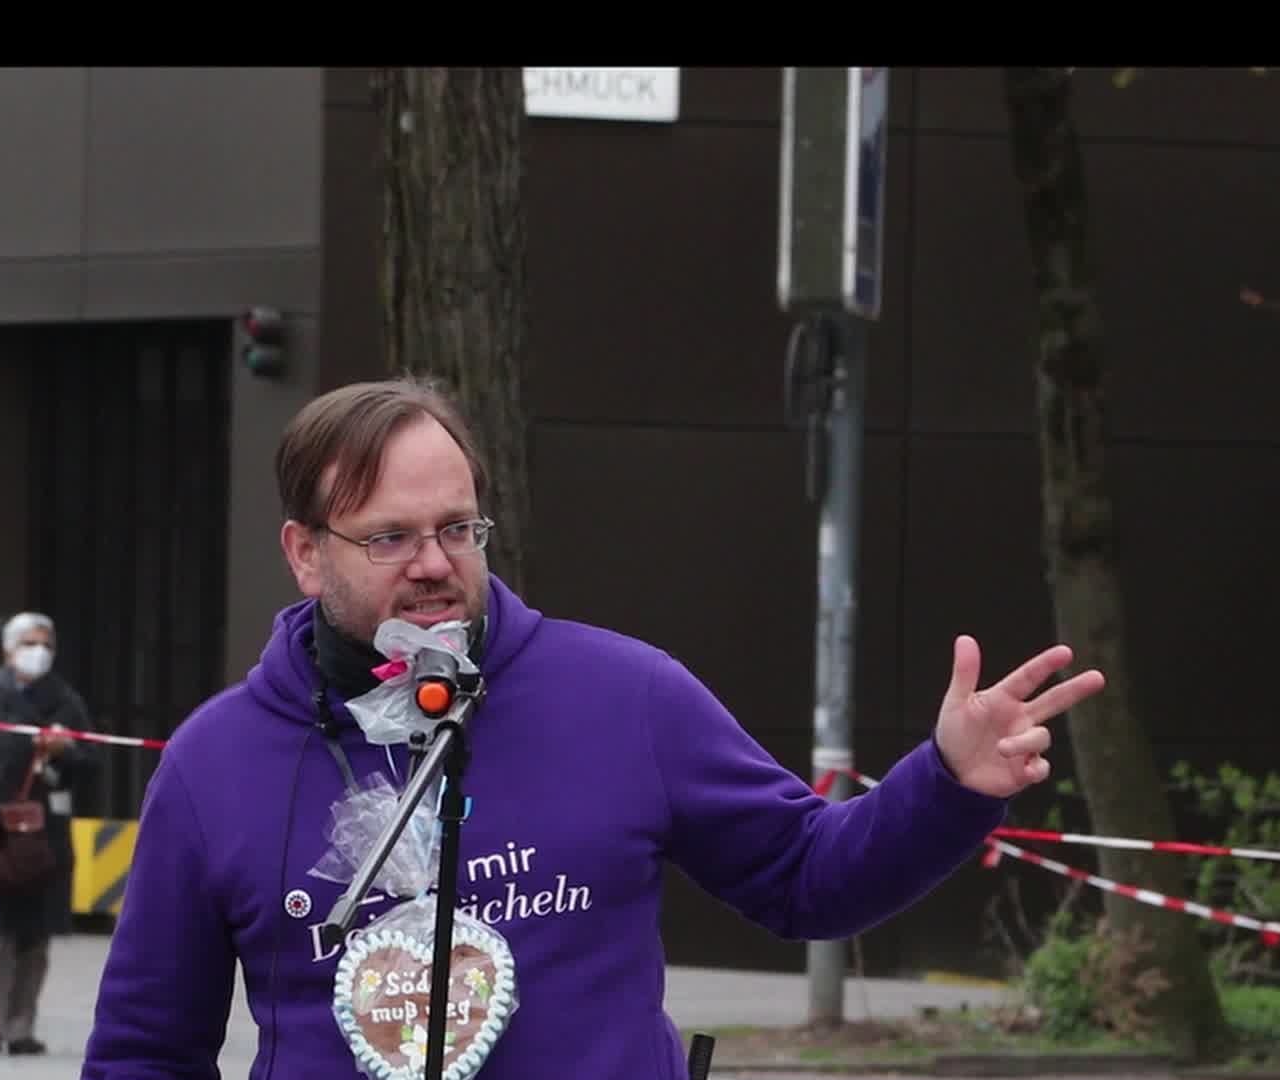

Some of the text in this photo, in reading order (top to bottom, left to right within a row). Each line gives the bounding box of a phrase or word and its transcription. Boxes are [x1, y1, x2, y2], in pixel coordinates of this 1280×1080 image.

[467, 841, 537, 881] mir
[455, 875, 593, 926] ächeln
[384, 969, 454, 996] Söd
[425, 999, 471, 1025] eg
